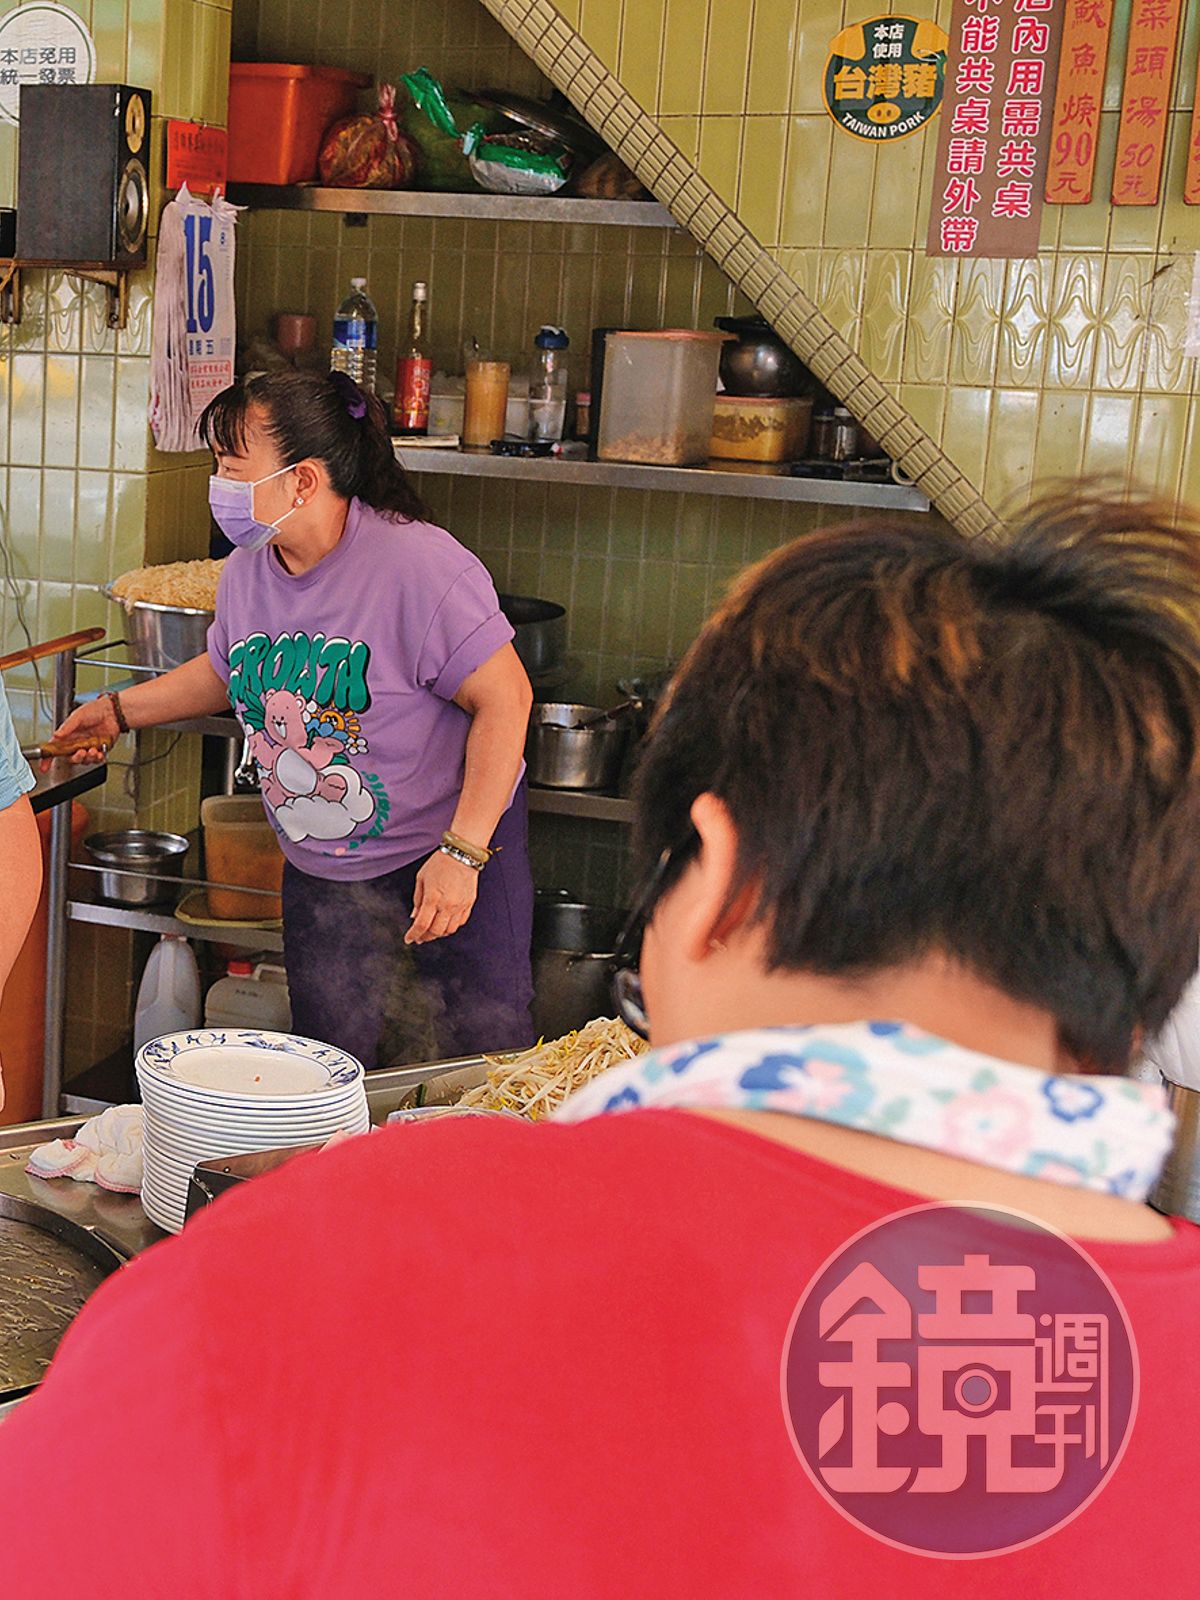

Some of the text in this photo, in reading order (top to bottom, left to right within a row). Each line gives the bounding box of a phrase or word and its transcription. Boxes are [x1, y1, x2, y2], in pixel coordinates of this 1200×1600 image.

[873, 23, 904, 40] 本店
[0, 47, 76, 65] 本店免用
[873, 43, 902, 58] 使用
[0, 67, 76, 85] 統一發票
[834, 63, 937, 100] 台灣豬
[842, 111, 925, 137] TAIWAN PORK
[184, 214, 215, 333] 15
